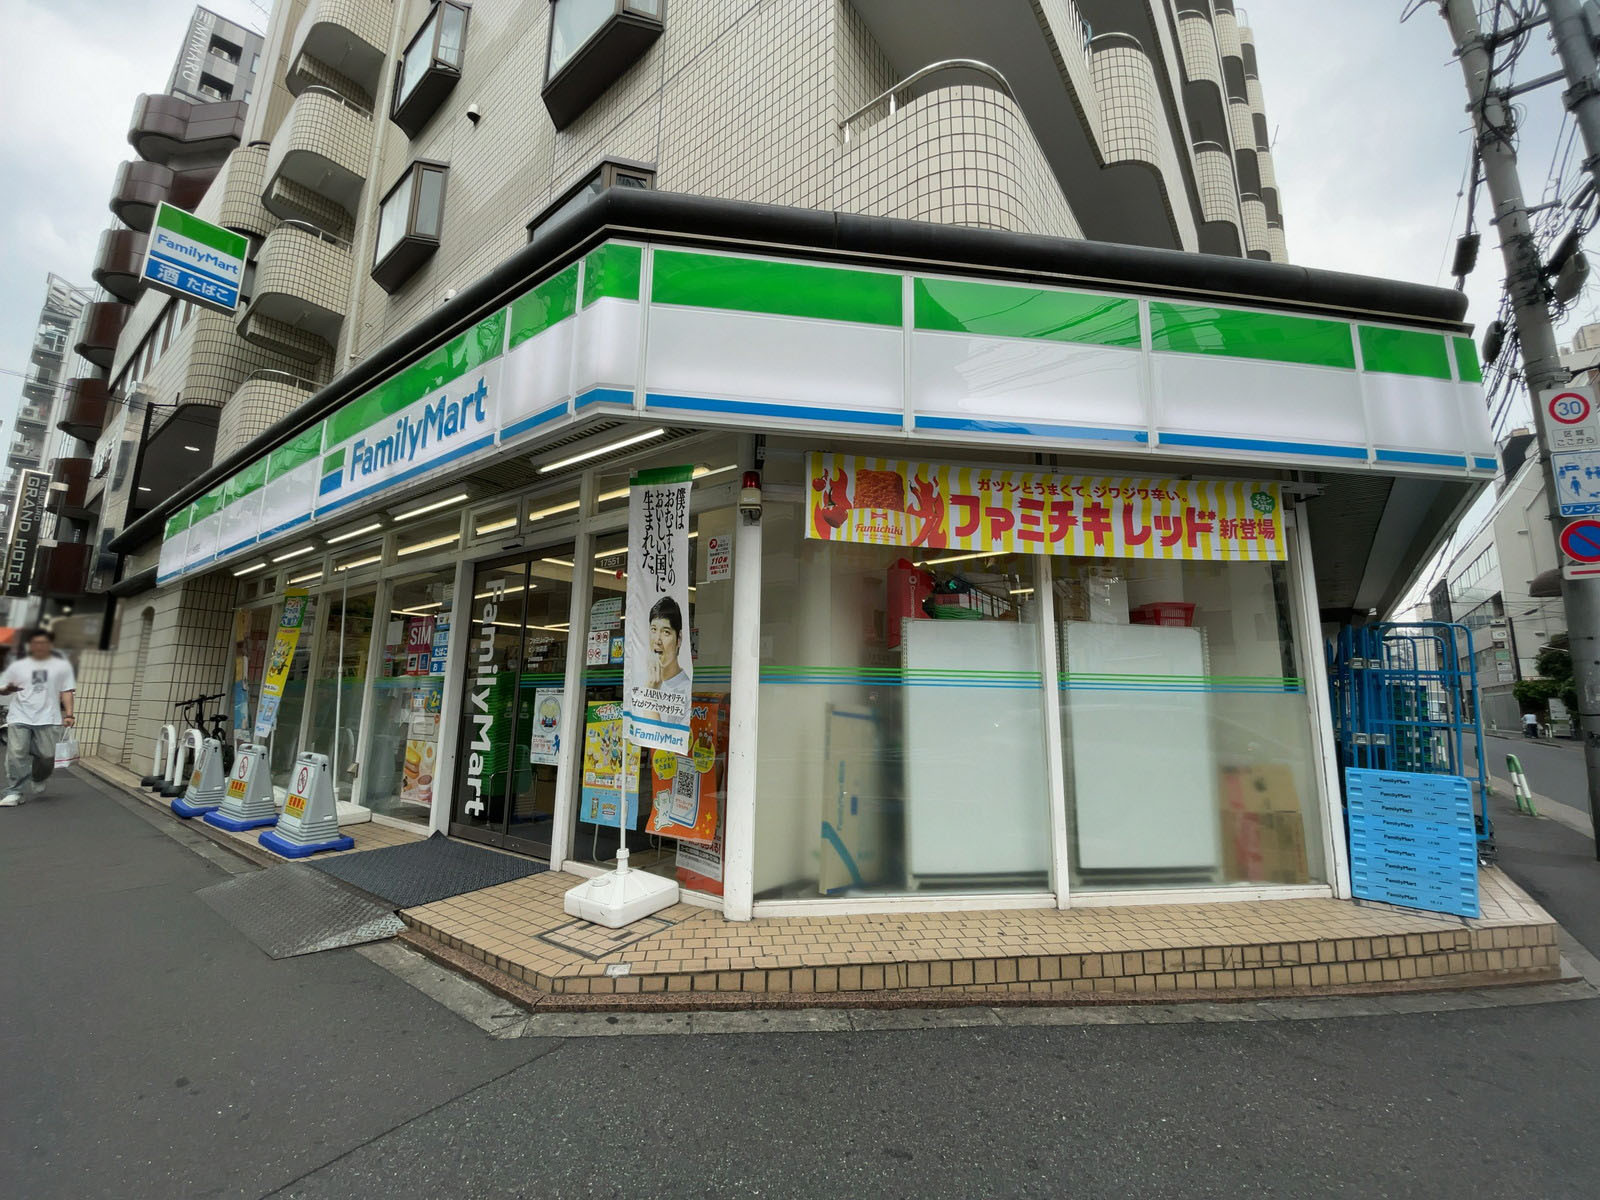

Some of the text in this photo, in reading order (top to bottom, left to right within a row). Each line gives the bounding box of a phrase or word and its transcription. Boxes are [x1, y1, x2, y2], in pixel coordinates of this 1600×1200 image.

[157, 233, 239, 275] FamilyMart
[157, 264, 229, 302] 酒 たばこ
[1558, 401, 1581, 416] 30
[350, 376, 488, 481] FamilyMart
[1557, 436, 1595, 447] ここから
[977, 478, 1188, 503] ガツンとうまくて、ジワジワ辛い。
[675, 487, 687, 530] 僕は
[7, 476, 40, 591] GRAND HOTEL
[642, 490, 655, 575] 生まれた。
[664, 489, 676, 587] おむすびの
[855, 523, 904, 537] Famichiki
[1219, 518, 1276, 541] 新登場
[655, 489, 667, 593] おいしい国に
[600, 556, 620, 567] 17551
[409, 625, 432, 646] SIM
[464, 578, 506, 817] FamilyMart
[634, 727, 684, 746] FamilyMart
[1382, 805, 1412, 813] FamilyMart
[1383, 820, 1414, 828] FamilyMart
[1384, 834, 1415, 842] FamilyMart
[1385, 849, 1415, 857] FamilyMart
[1385, 863, 1416, 872] FamilyMart
[1386, 878, 1416, 886] FamilyMart
[1386, 892, 1418, 901] FamilyMart
